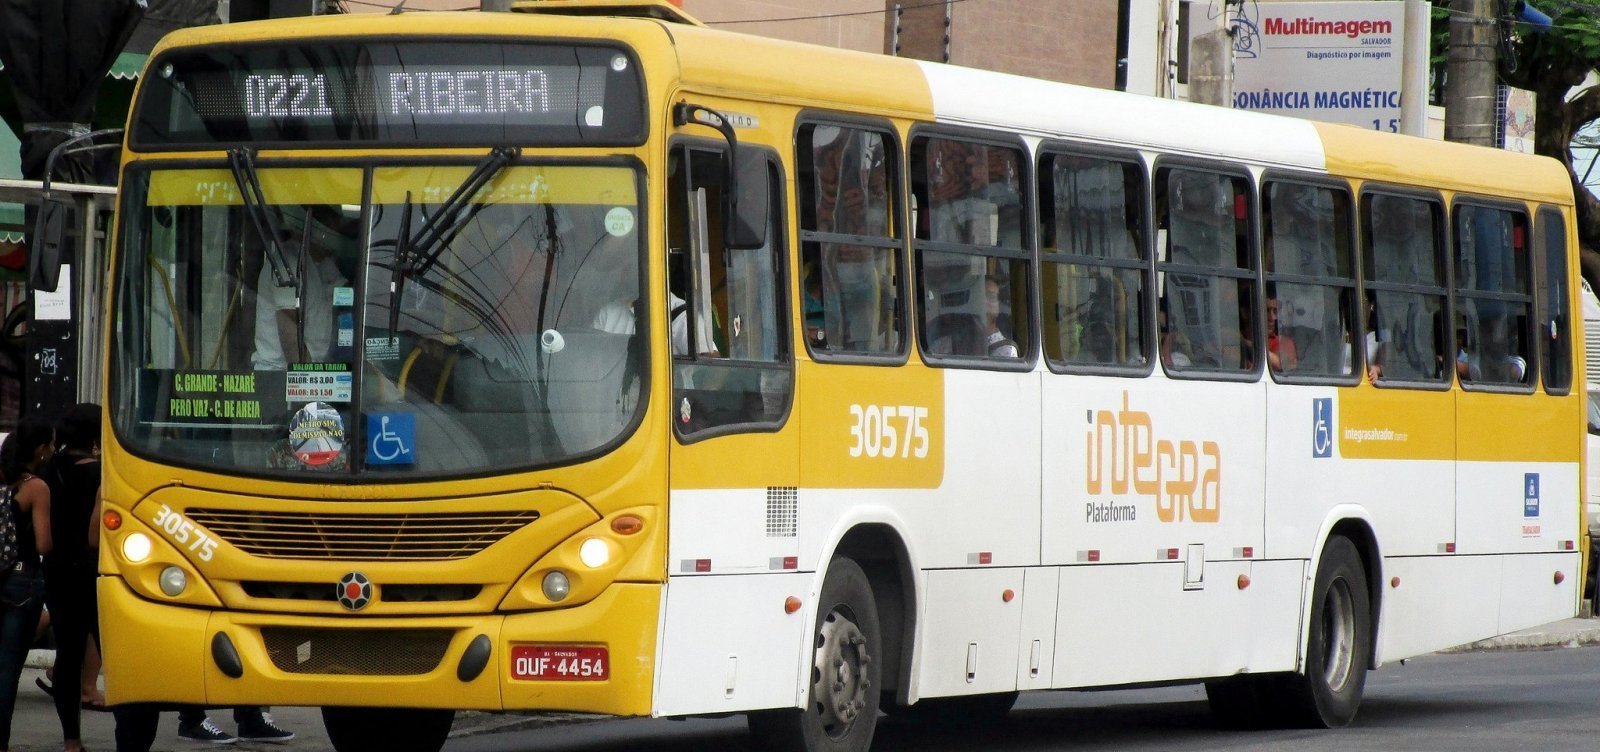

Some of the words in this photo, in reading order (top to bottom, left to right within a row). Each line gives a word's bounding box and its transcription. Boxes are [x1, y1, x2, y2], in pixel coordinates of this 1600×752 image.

[1264, 17, 1392, 38] Multimagem
[1306, 50, 1348, 59] Diagnóstico
[1349, 52, 1361, 60] por
[1362, 51, 1392, 60] imagem
[245, 74, 332, 116] 0221
[388, 70, 549, 114] RIBEIRA
[1314, 87, 1402, 109] MAGNÉTIC
[175, 373, 183, 391] C.
[184, 374, 218, 392] GRANDE
[224, 373, 256, 392] NAZARÉ
[170, 399, 191, 416] PERO
[192, 399, 208, 417] VAZ
[214, 400, 223, 418] C.
[224, 400, 235, 418] DE
[236, 400, 260, 418] AREIA
[849, 404, 929, 458] 30575
[1086, 500, 1136, 523] Plataforma
[152, 503, 218, 562] 30575
